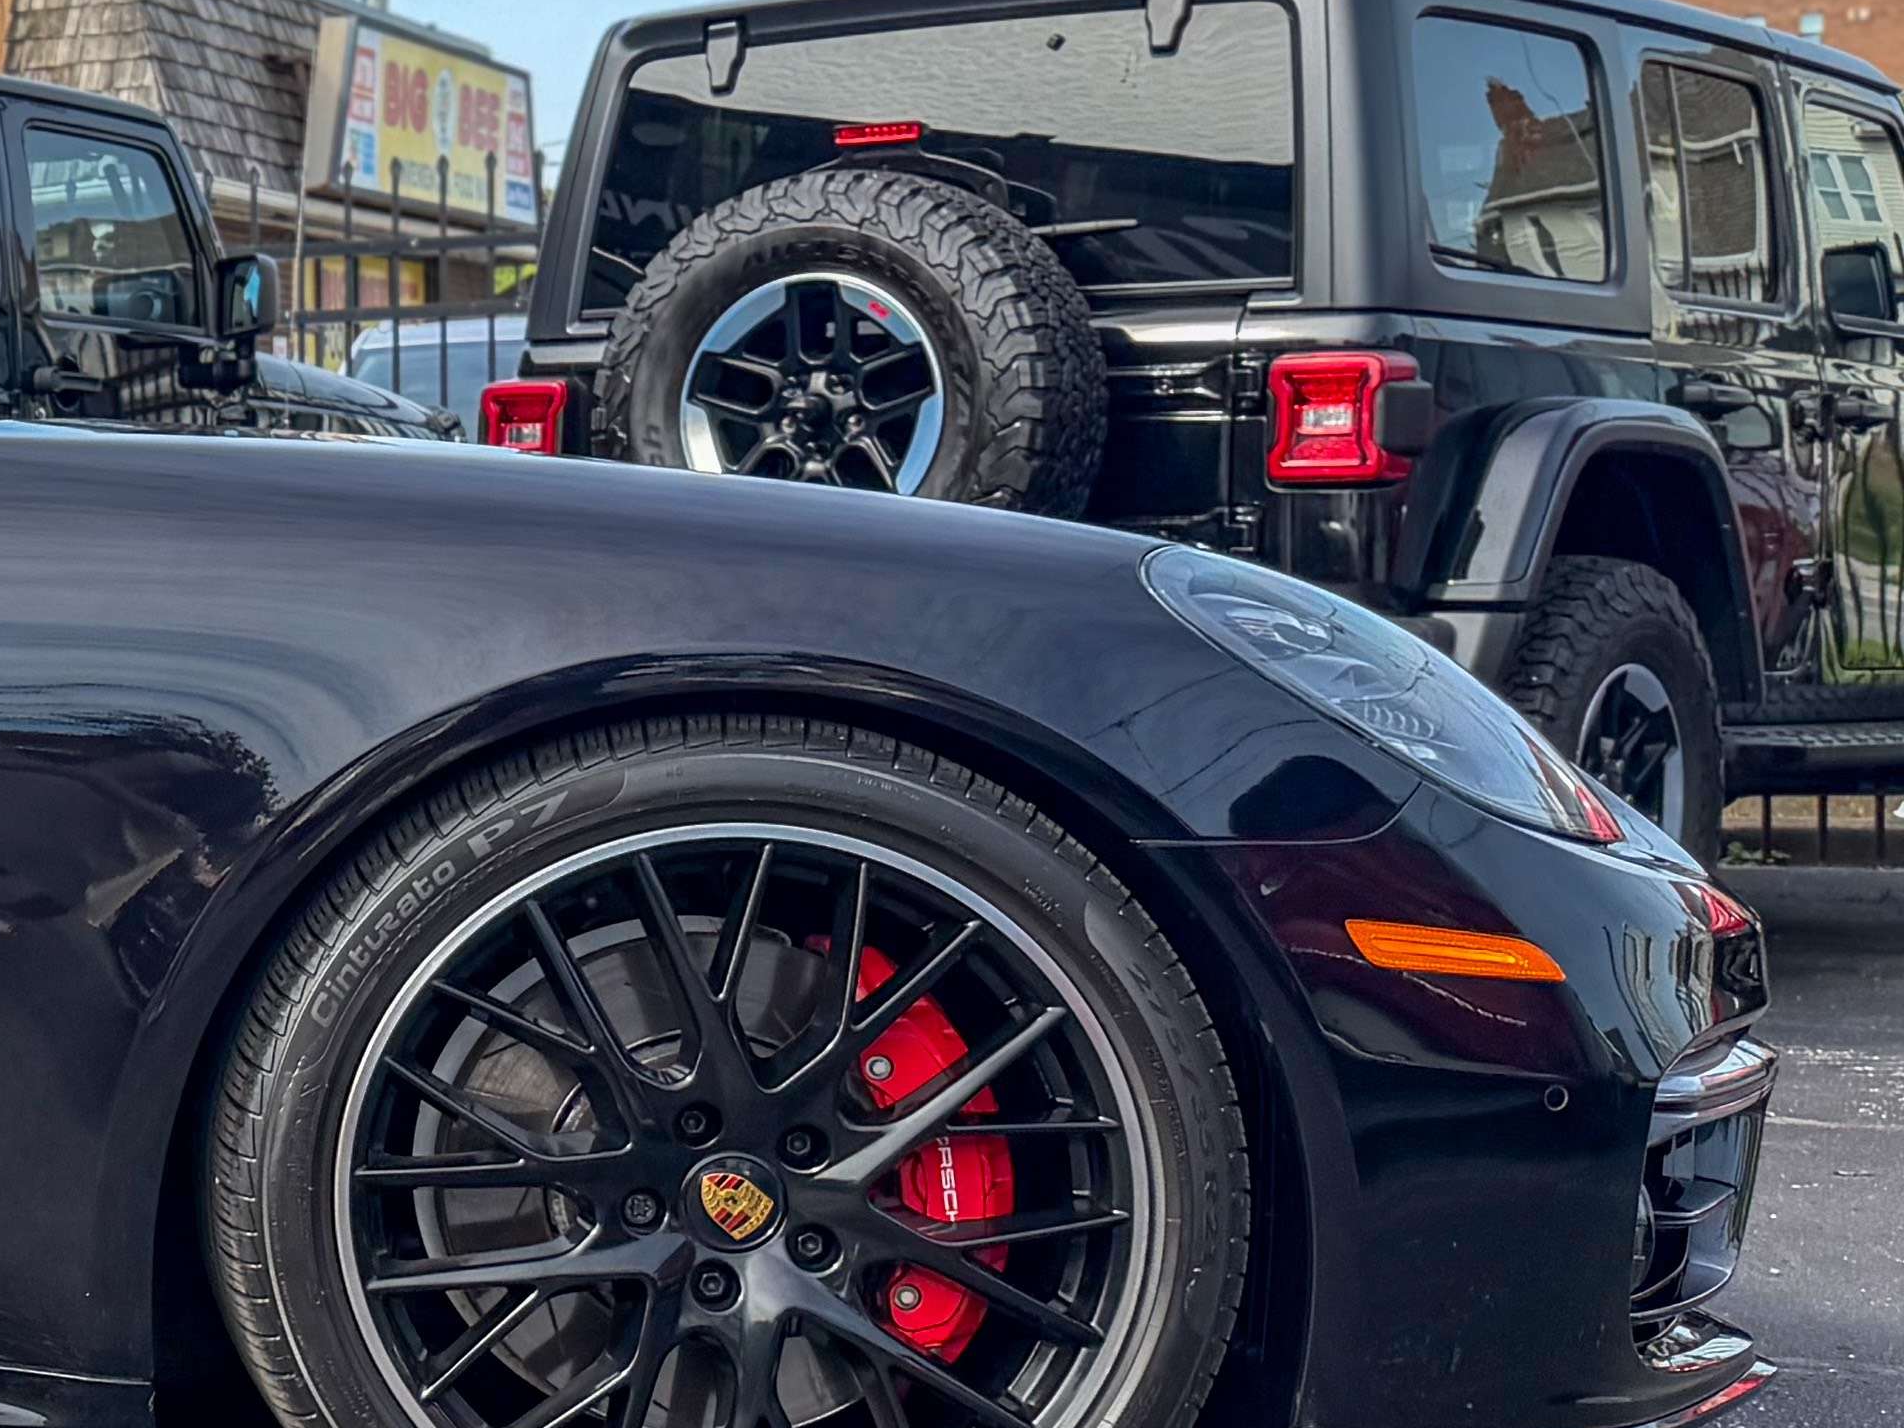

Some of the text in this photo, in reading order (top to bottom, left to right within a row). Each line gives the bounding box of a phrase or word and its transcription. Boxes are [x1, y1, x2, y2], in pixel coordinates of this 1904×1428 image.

[384, 60, 429, 134] BIG
[459, 84, 501, 152] BEE
[309, 790, 569, 1028] Cinturato P7
[936, 1136, 959, 1223] RSCH
